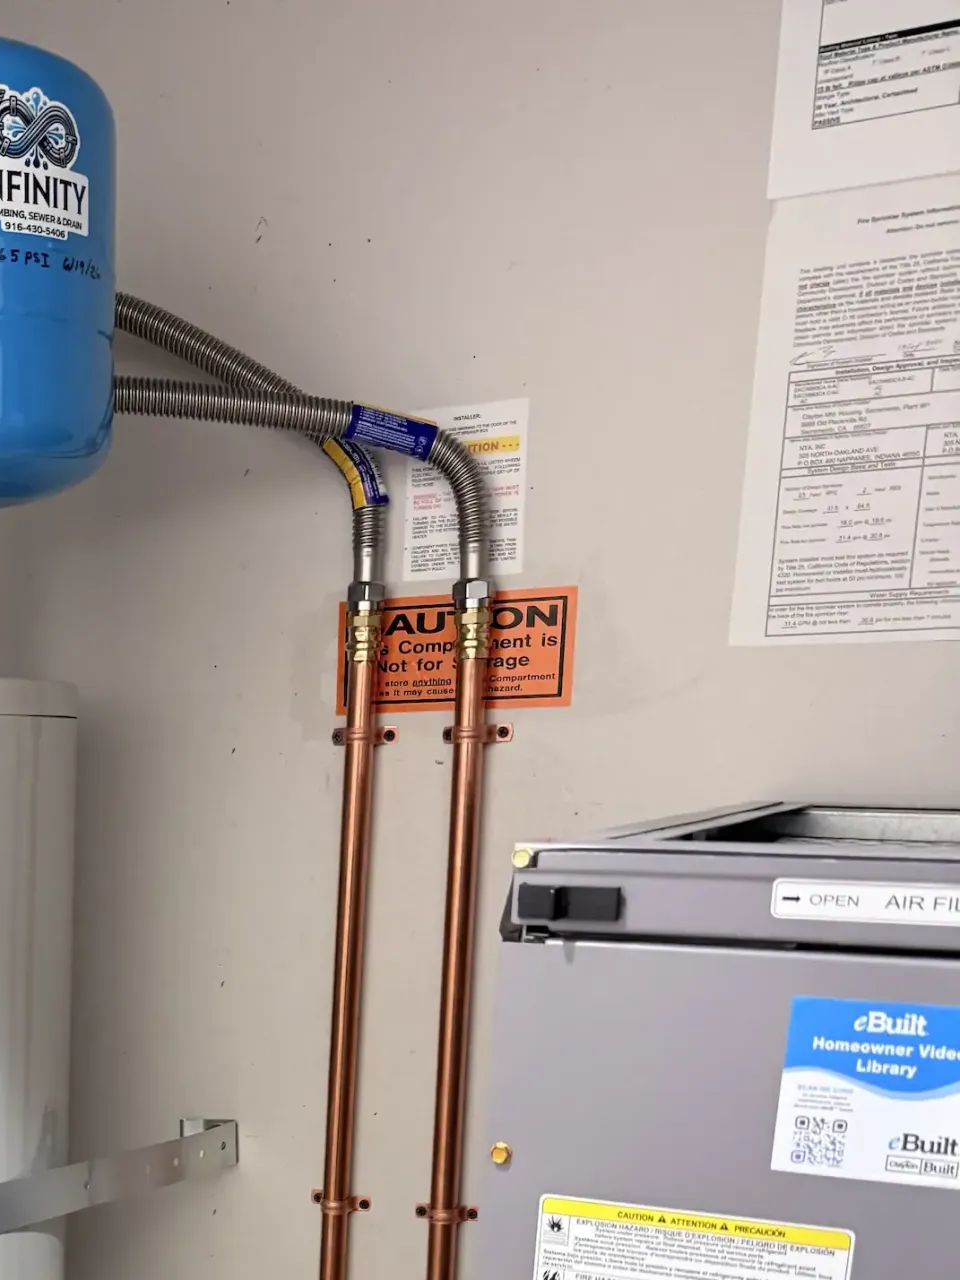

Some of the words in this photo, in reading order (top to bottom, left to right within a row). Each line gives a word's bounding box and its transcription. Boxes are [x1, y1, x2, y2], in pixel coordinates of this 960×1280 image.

[4, 221, 66, 238] 916-430-5406
[28, 211, 56, 225] SEWER
[57, 216, 62, 224] &
[63, 217, 83, 231] DRAIN
[542, 634, 558, 647] is
[378, 660, 407, 673] Not
[417, 658, 443, 672] for
[412, 677, 452, 687] anything
[490, 673, 556, 684] Compartment
[404, 688, 422, 697] may
[427, 688, 455, 696] cause
[809, 893, 860, 907] OPEN
[885, 894, 925, 911] AIR
[853, 1010, 929, 1036] eBuilt
[812, 1037, 914, 1057] Homeowner
[920, 1040, 960, 1061] Vide
[856, 1058, 917, 1080] Library
[889, 1132, 959, 1156] eBuilt
[923, 1162, 956, 1176] Built
[576, 1218, 618, 1230] EXPLOSION
[619, 1223, 650, 1232] HAZARD
[617, 1211, 654, 1222] CAUTION
[670, 1217, 717, 1230] ATTENTION
[734, 1225, 786, 1238] PRECAUCIÓN
